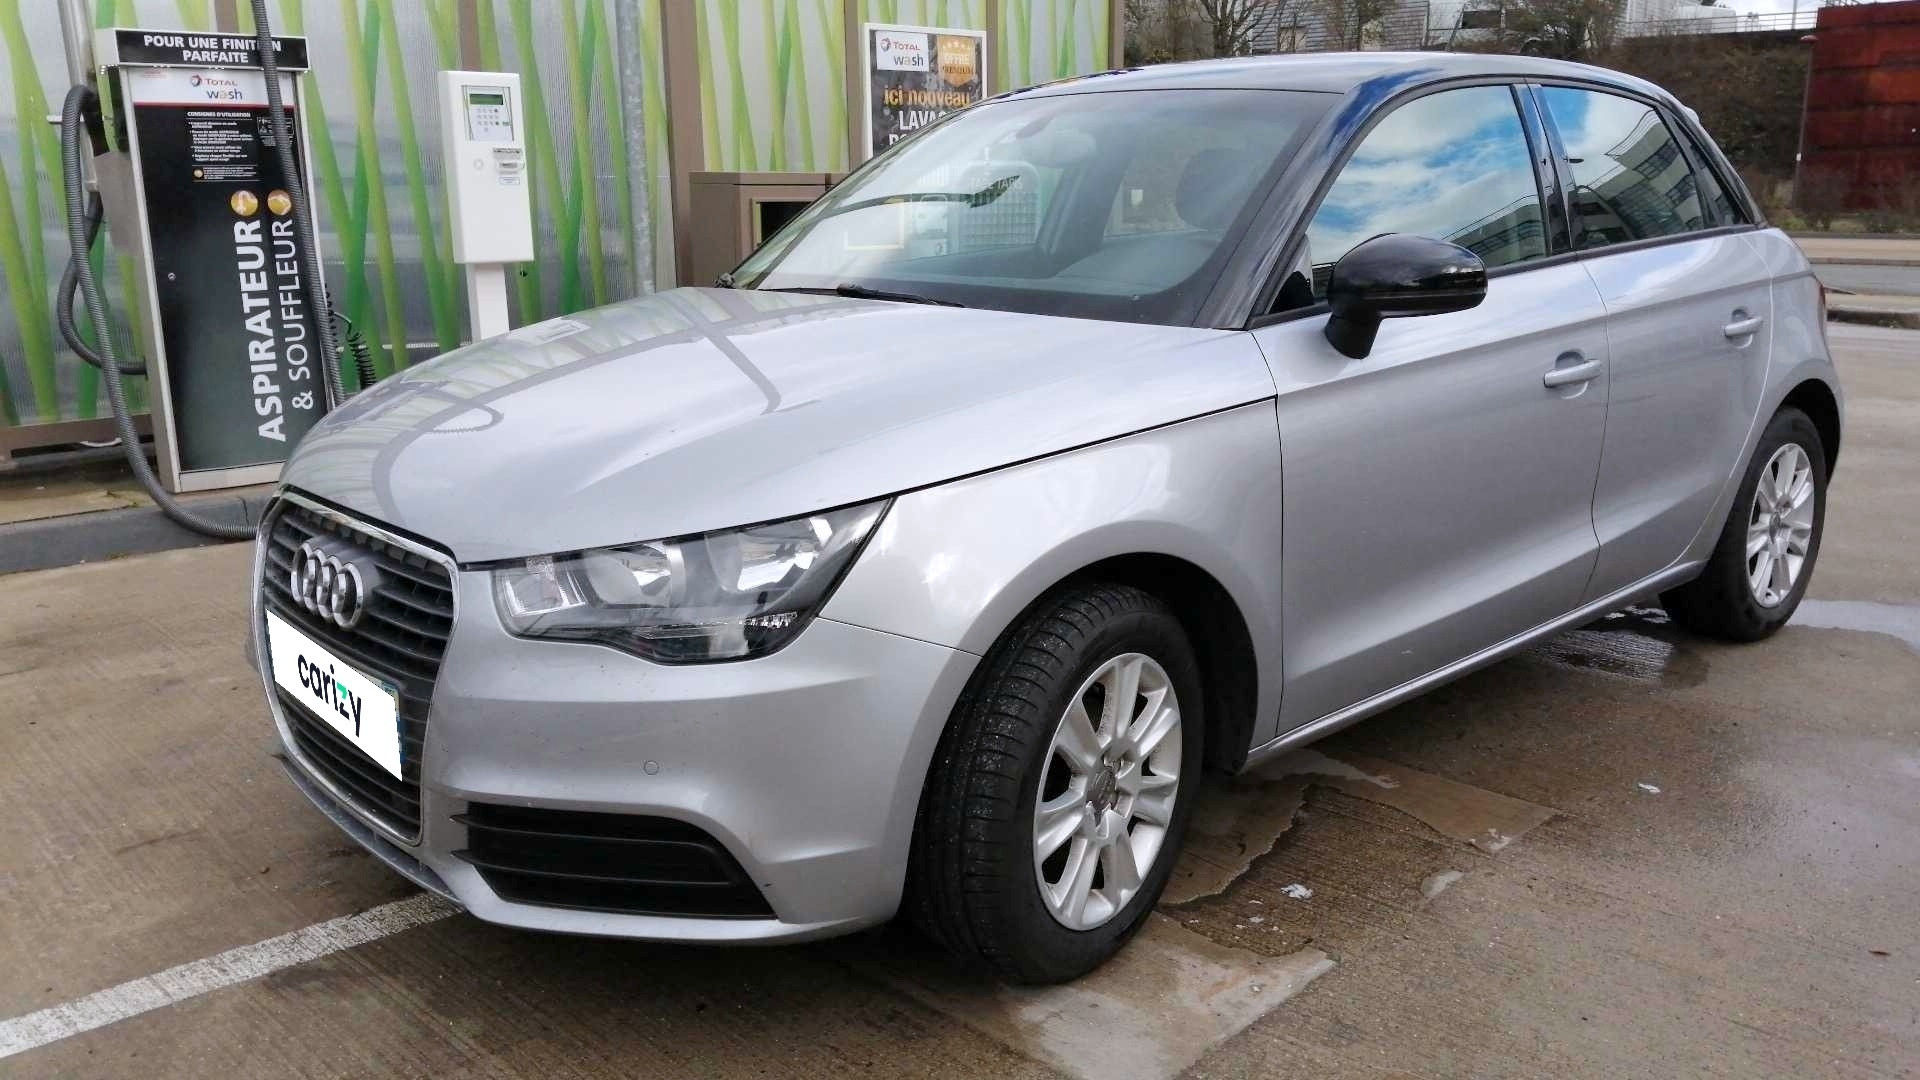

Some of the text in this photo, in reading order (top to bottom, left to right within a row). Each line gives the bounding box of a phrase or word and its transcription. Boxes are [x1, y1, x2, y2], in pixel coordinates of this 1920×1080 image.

[144, 34, 281, 52] POUR UNE FINITN
[893, 42, 921, 51] TOTAL
[182, 50, 249, 63] PARFAITE
[894, 53, 924, 67] wash
[205, 78, 239, 87] TOTAL
[206, 88, 243, 100] wash
[884, 84, 970, 108] ici nouveau
[898, 110, 947, 131] LAVA
[271, 218, 314, 410] & SOUFFLEUR
[233, 219, 287, 443] ASPIRATEUR
